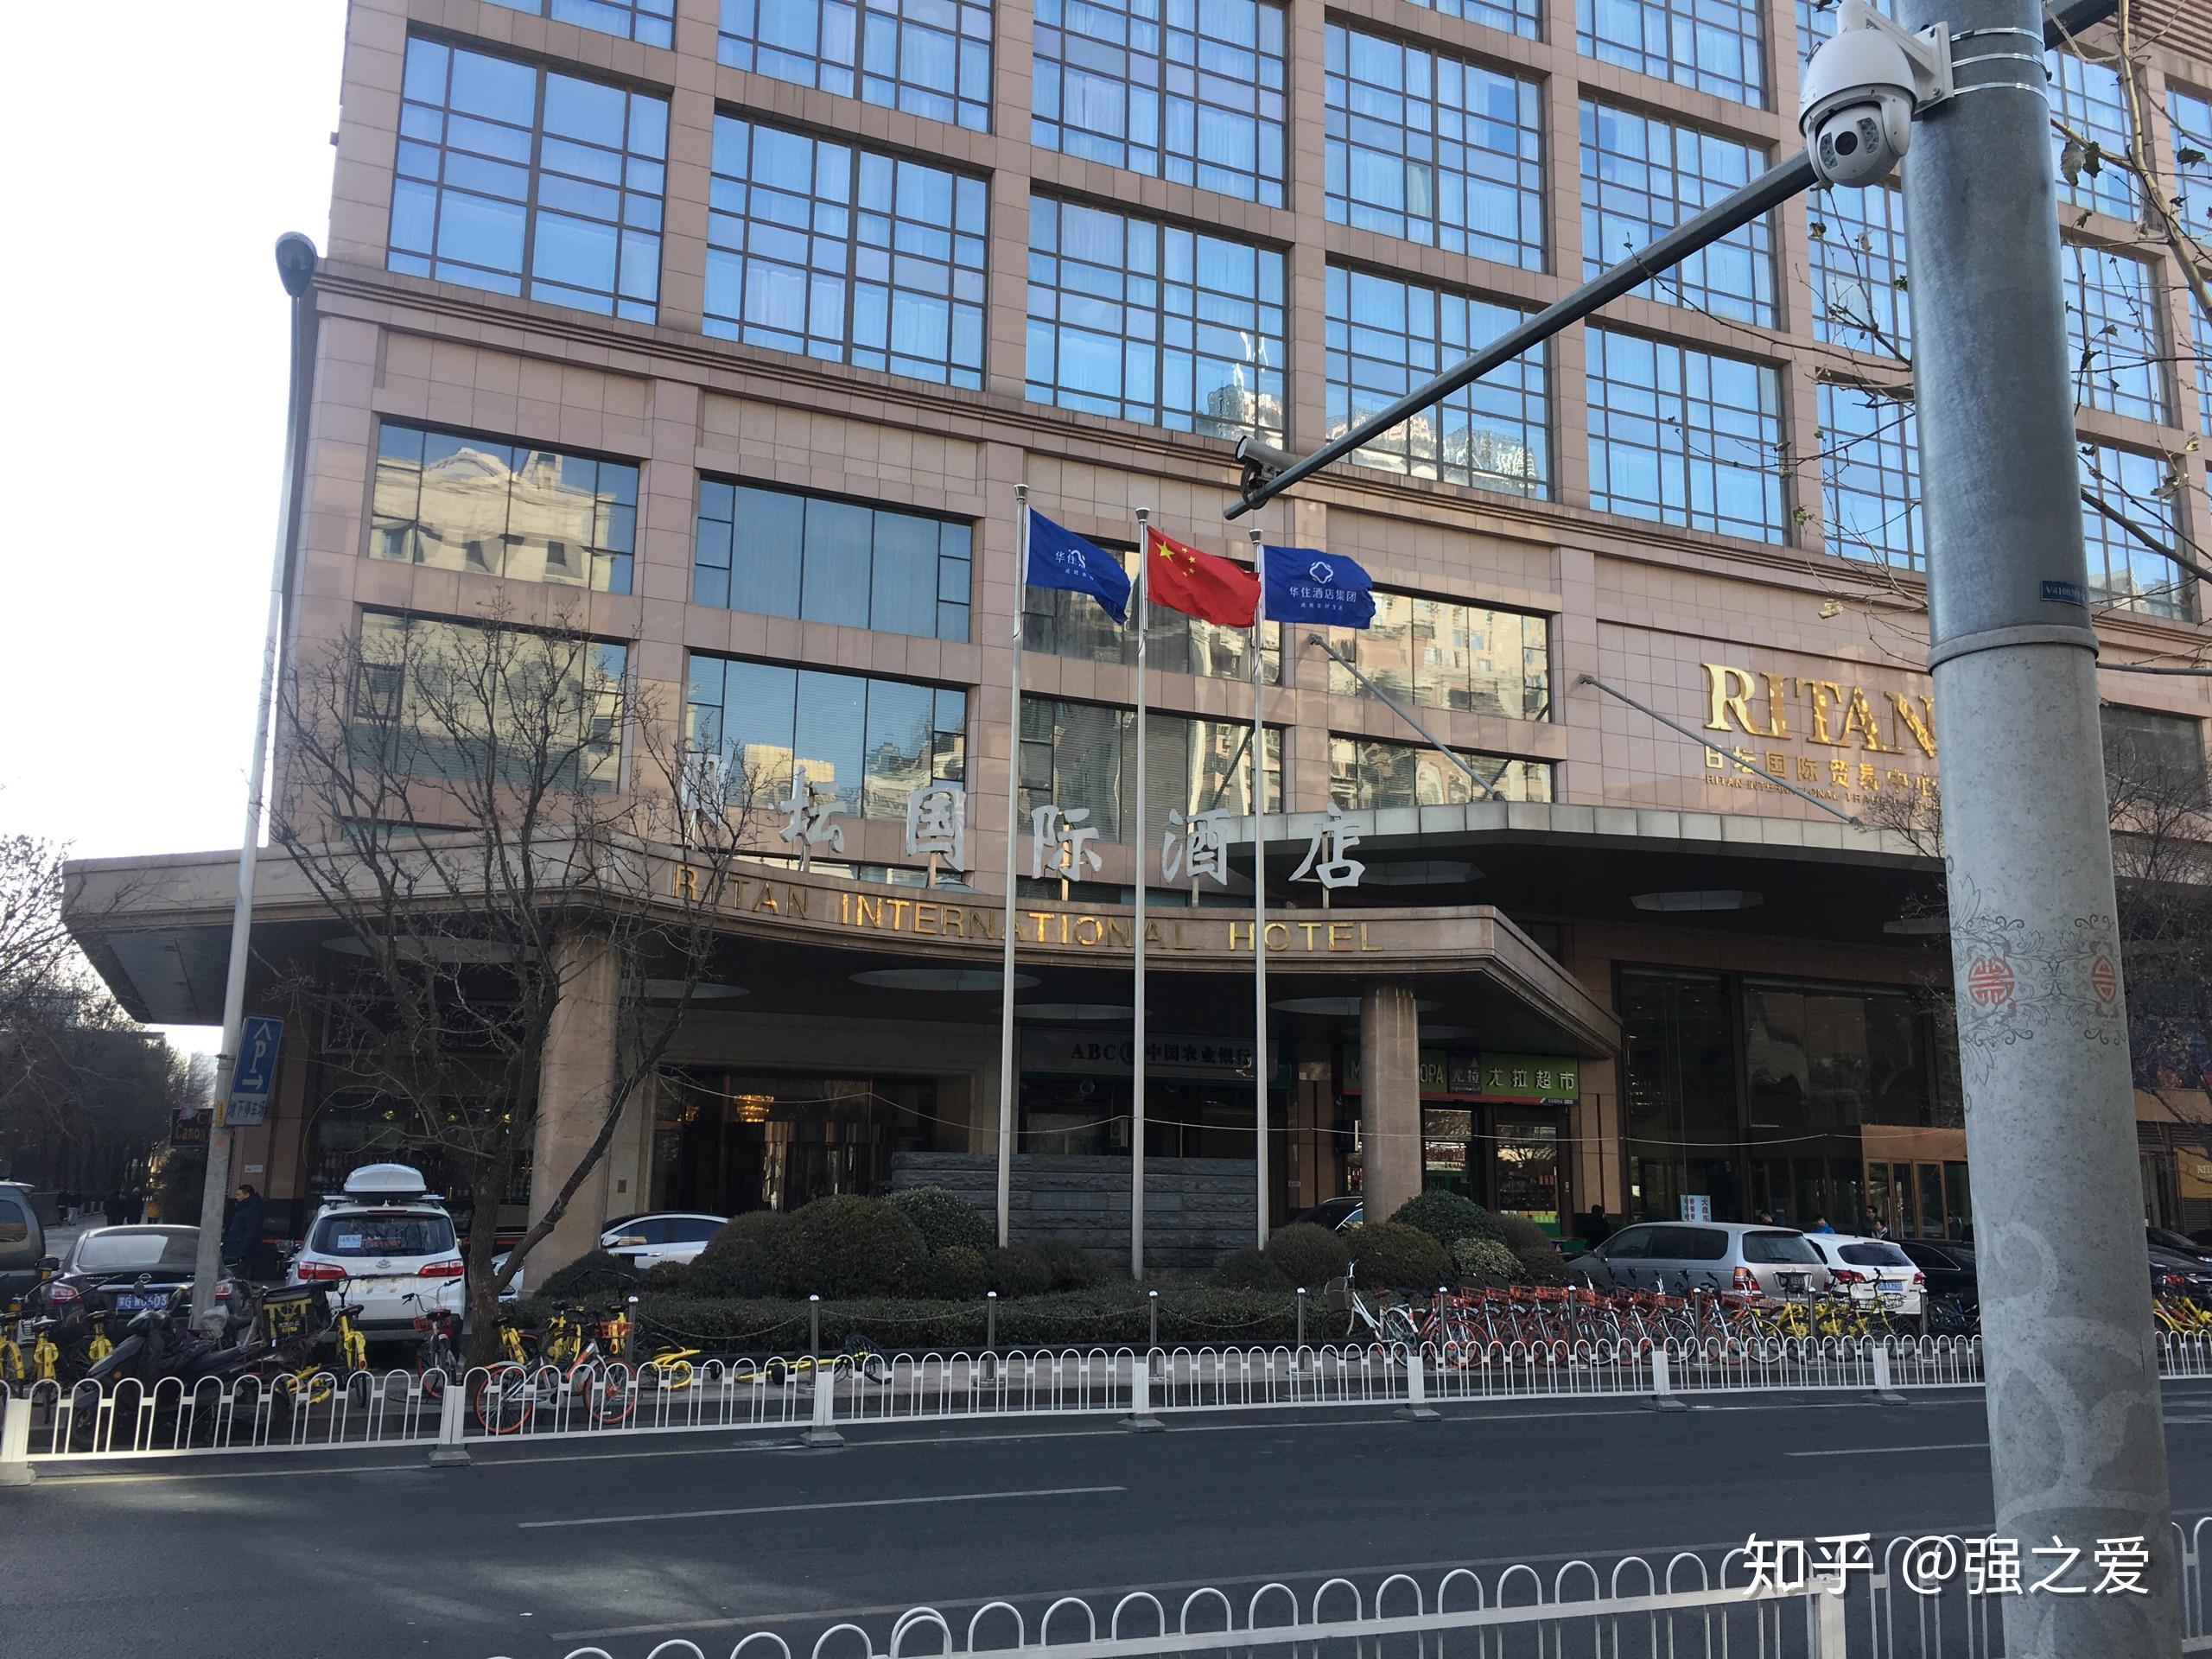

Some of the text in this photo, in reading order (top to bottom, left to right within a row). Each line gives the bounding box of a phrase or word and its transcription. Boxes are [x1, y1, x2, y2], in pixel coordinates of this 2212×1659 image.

[1289, 587, 1357, 603] 华住酒店集团
[1700, 663, 1937, 759] RITAN
[1707, 773, 1742, 789] RITAN
[672, 864, 809, 920] RITAN
[1230, 921, 1382, 951] HOTEL
[1071, 1042, 1116, 1060] ABC
[1146, 1043, 1254, 1066] 中国农业银行
[1489, 1068, 1575, 1091] 尤拉超市
